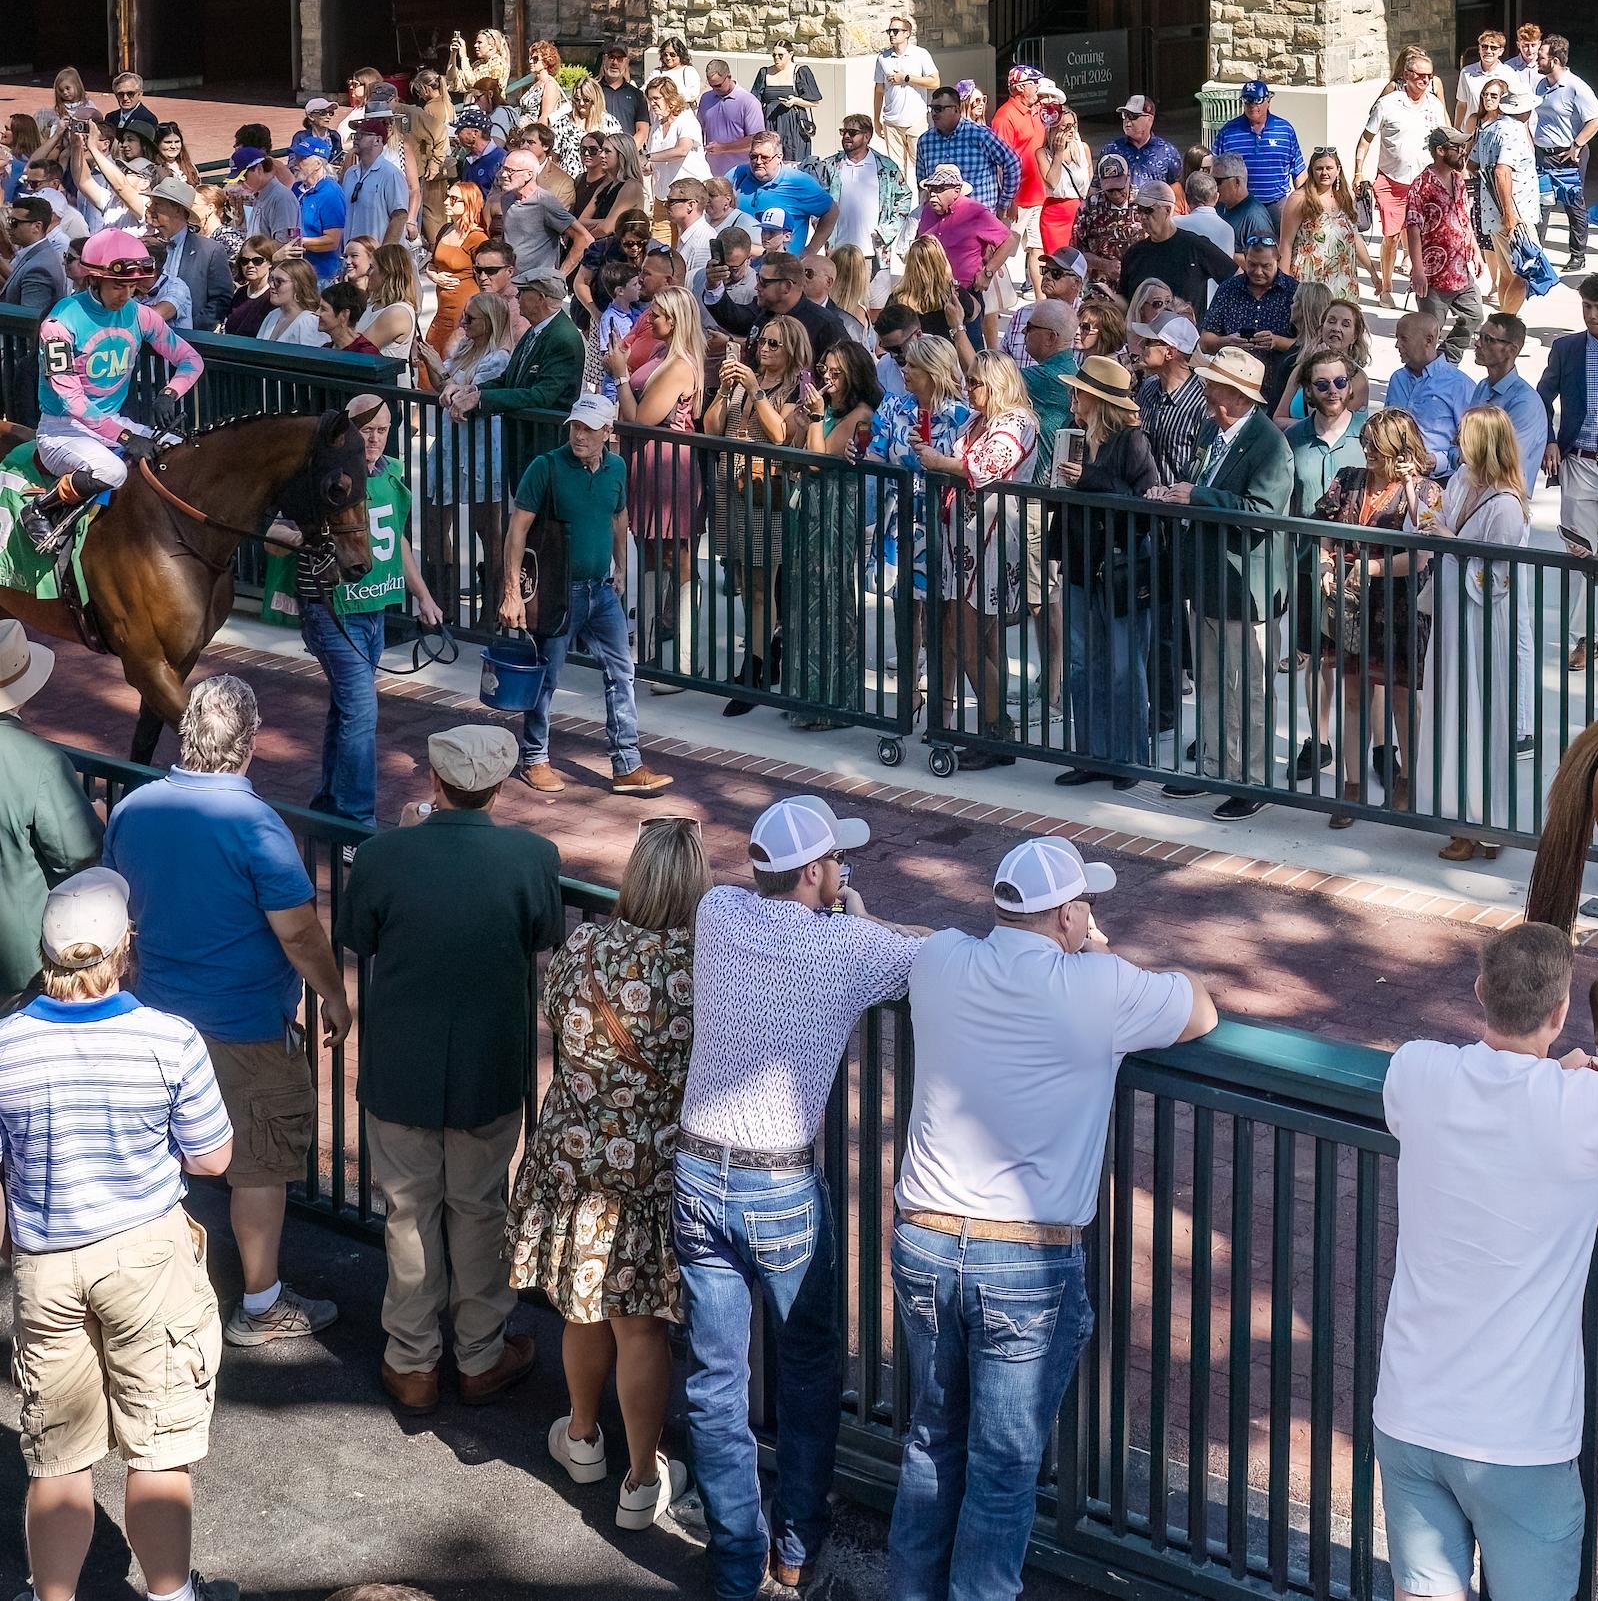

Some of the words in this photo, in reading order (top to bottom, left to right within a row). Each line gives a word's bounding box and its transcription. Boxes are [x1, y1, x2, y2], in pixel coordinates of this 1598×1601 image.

[1067, 49, 1105, 65] Coming
[1062, 70, 1087, 89] April
[1088, 68, 1113, 84] 2026
[764, 211, 774, 222] H
[48, 341, 69, 373] 5
[85, 346, 131, 379] CM
[367, 503, 396, 562] 5
